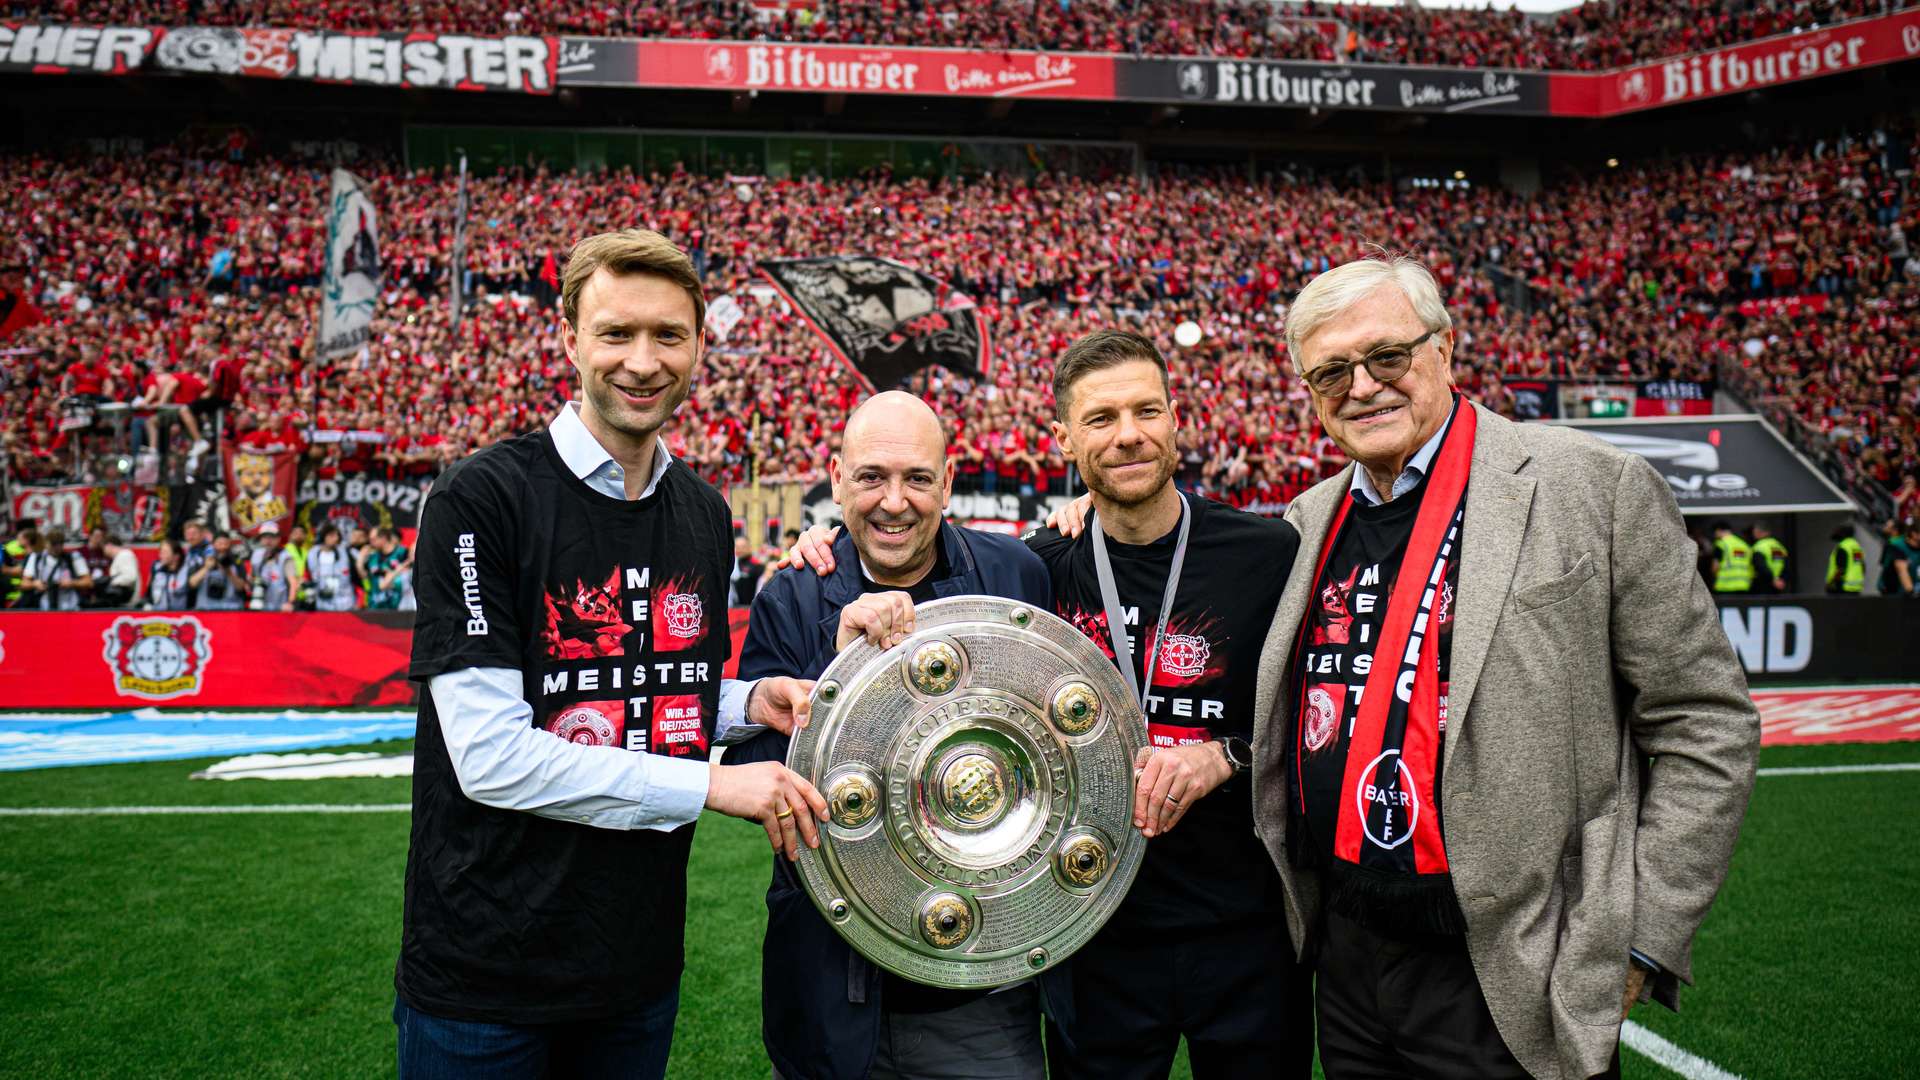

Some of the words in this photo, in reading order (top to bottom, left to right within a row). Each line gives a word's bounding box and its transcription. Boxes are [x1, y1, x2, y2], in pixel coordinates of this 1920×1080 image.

[296, 34, 549, 89] MEISTER
[746, 46, 919, 90] Bitburger
[1663, 35, 1865, 101] Bitburger
[1216, 62, 1376, 106] Bitburger
[345, 479, 421, 512] BOYZ
[454, 533, 489, 636] Barmenia
[1721, 606, 1813, 673] ND
[543, 661, 709, 695] MEISTER
[665, 707, 685, 719] WIR.
[665, 730, 699, 743] MEISTER.
[1153, 734, 1177, 747] WIR.
